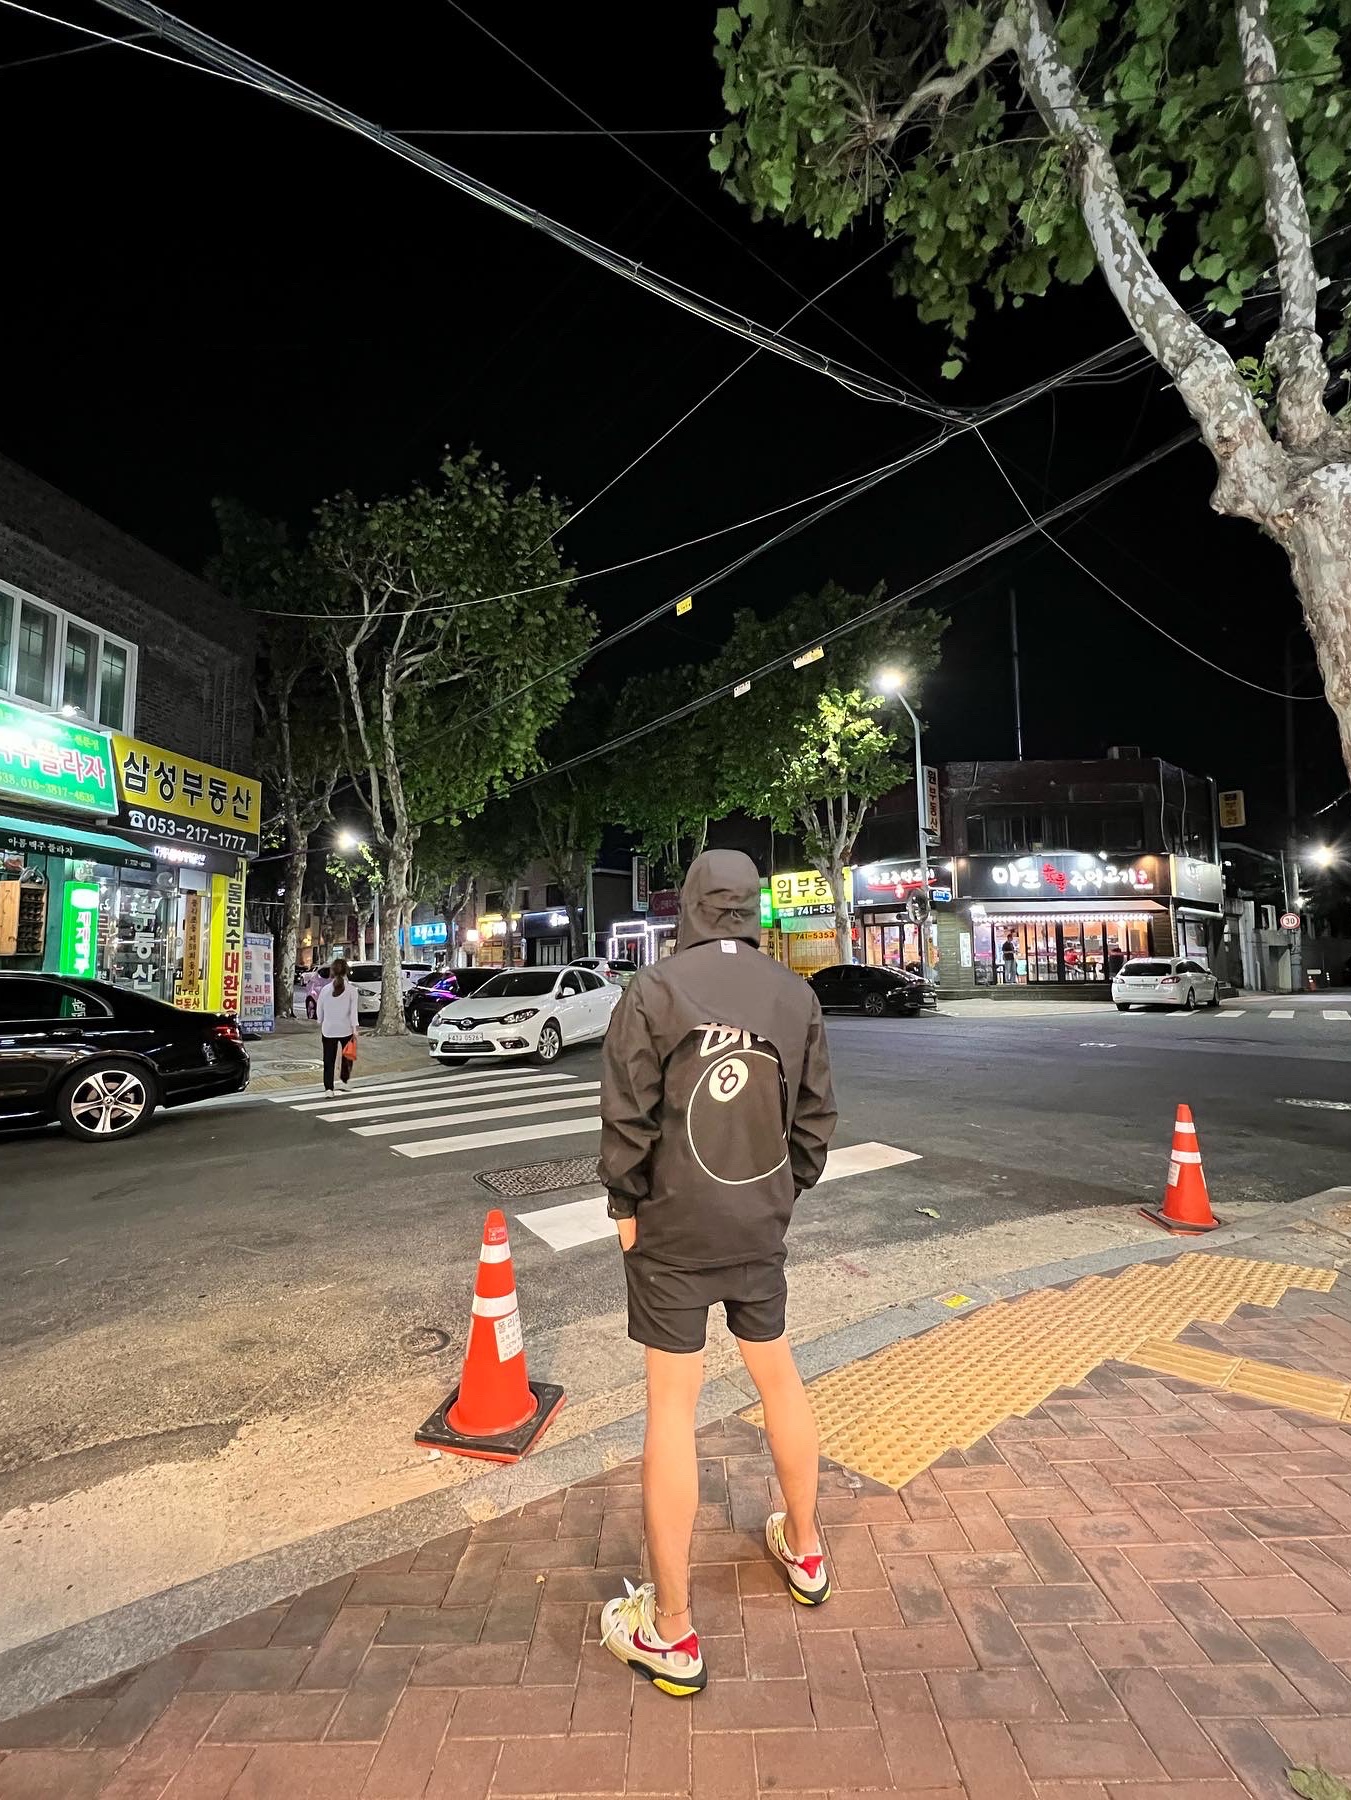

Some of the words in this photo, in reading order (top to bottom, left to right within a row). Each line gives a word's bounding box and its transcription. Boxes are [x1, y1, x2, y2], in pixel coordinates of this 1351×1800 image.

[123, 751, 251, 821] 삼성부동산
[147, 815, 247, 851] 053-217-1777
[796, 931, 835, 940] 741-5353
[1285, 917, 1296, 925] 30
[718, 1064, 739, 1094] 8
